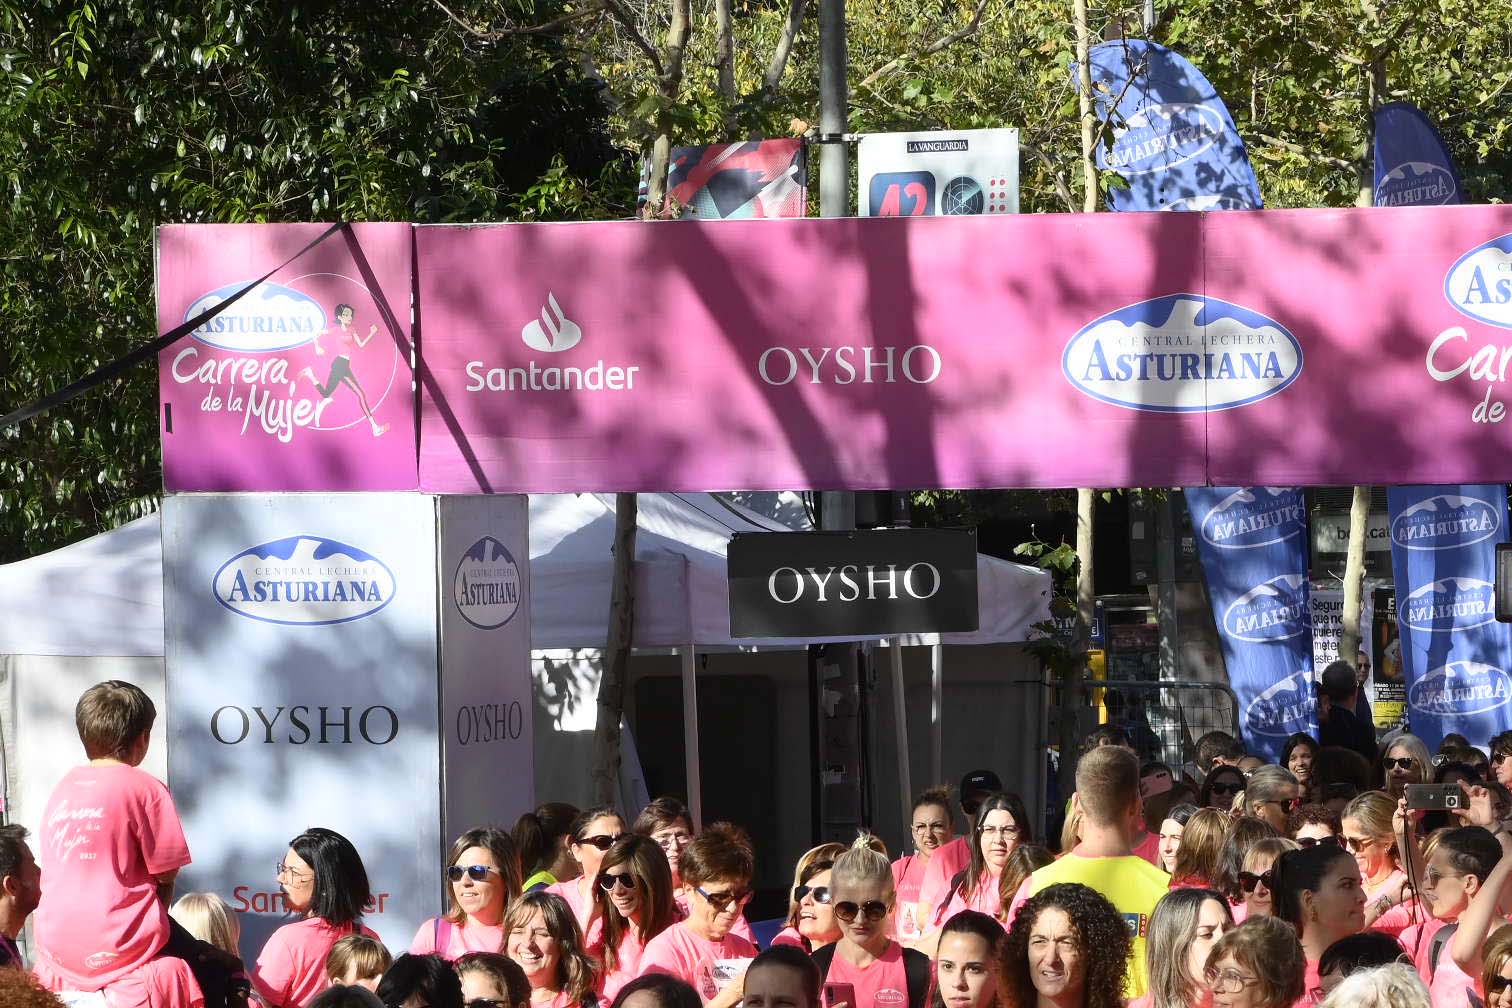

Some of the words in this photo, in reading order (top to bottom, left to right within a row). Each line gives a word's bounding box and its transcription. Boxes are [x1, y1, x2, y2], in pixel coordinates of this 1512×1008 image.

[908, 142, 919, 152] LA
[918, 141, 968, 152] VANGUARDIA
[194, 306, 314, 333] ASTURIANA
[1118, 335, 1194, 346] CENTRAL
[1201, 334, 1277, 346] LECHERA
[172, 347, 292, 384] Carrera
[465, 360, 640, 392] Santander
[757, 343, 942, 385] OYSHO
[1081, 339, 1285, 382] ASTURIANA
[200, 387, 223, 412] de
[227, 385, 243, 412] la
[240, 381, 334, 443] Mujer
[1471, 385, 1506, 424] de
[228, 569, 384, 603] ASTURIANA
[255, 567, 314, 576] CENTRAL
[459, 572, 518, 606] ASTURIANA
[767, 561, 942, 605] OYSHO
[210, 705, 399, 745] OYSHO
[456, 701, 523, 746] OYSHO
[233, 885, 390, 913] Saner
